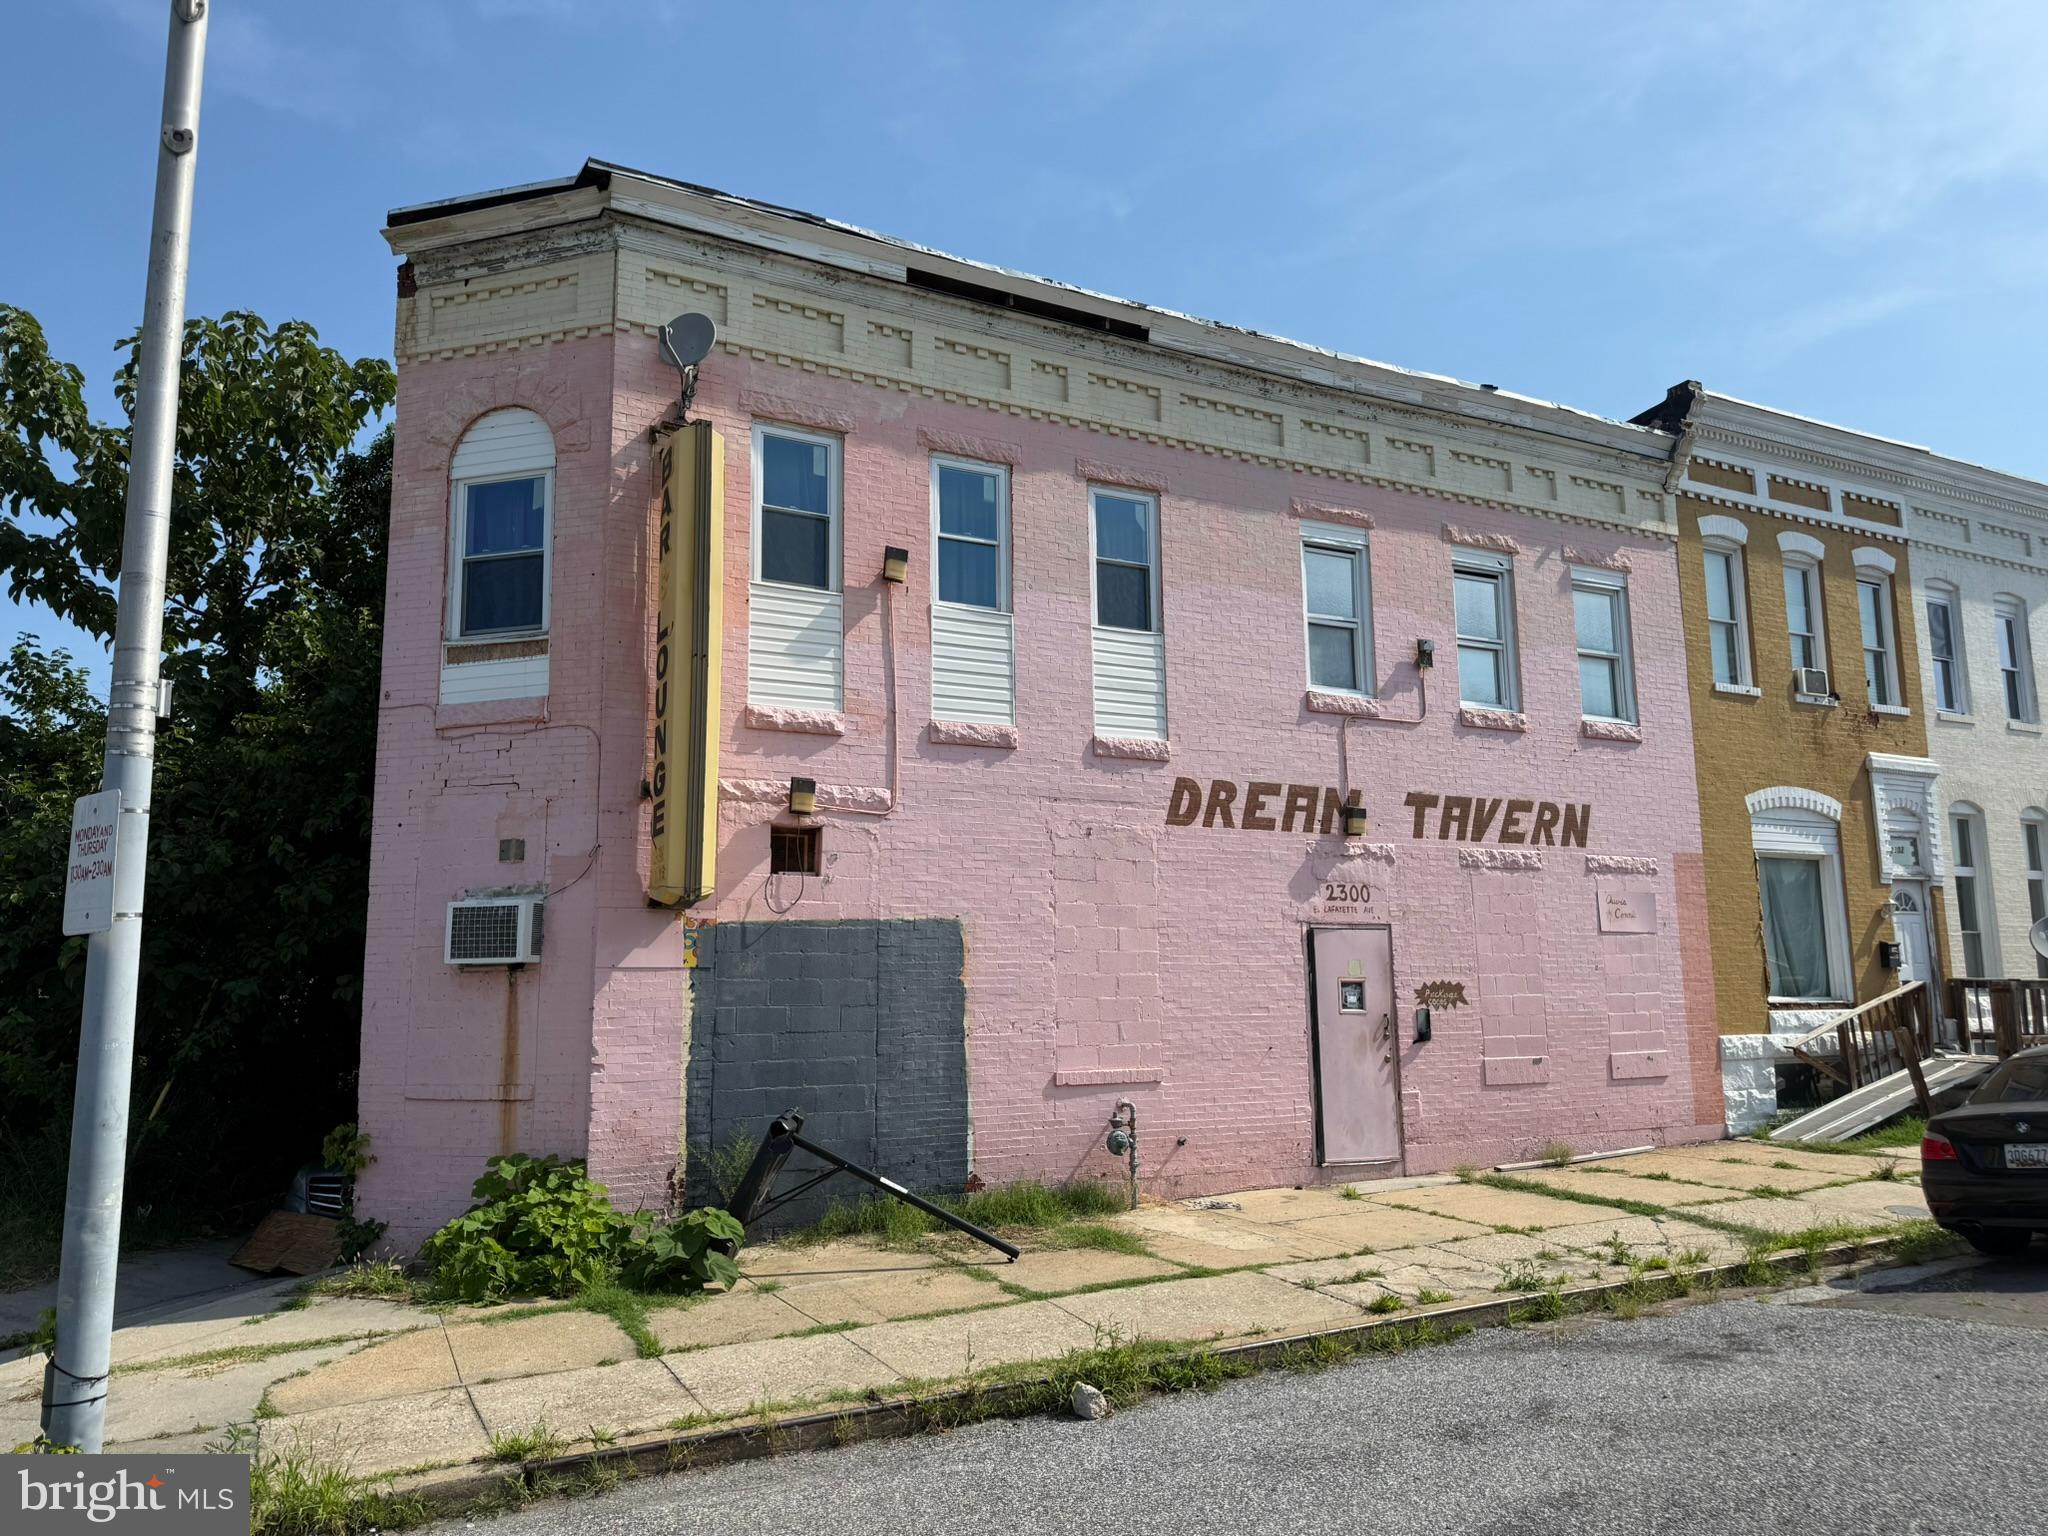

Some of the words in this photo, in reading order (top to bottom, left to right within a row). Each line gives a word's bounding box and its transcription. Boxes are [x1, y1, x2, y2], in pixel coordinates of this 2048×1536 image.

[660, 446, 673, 563] BAR
[653, 611, 669, 839] LOUNGE
[1403, 791, 1592, 848] TAVERN
[75, 825, 101, 842] MONDAY
[100, 825, 113, 837] AND
[78, 838, 108, 856] THURSDAY
[1325, 884, 1371, 903] 2300
[1323, 905, 1359, 914] LAFAYETTE
